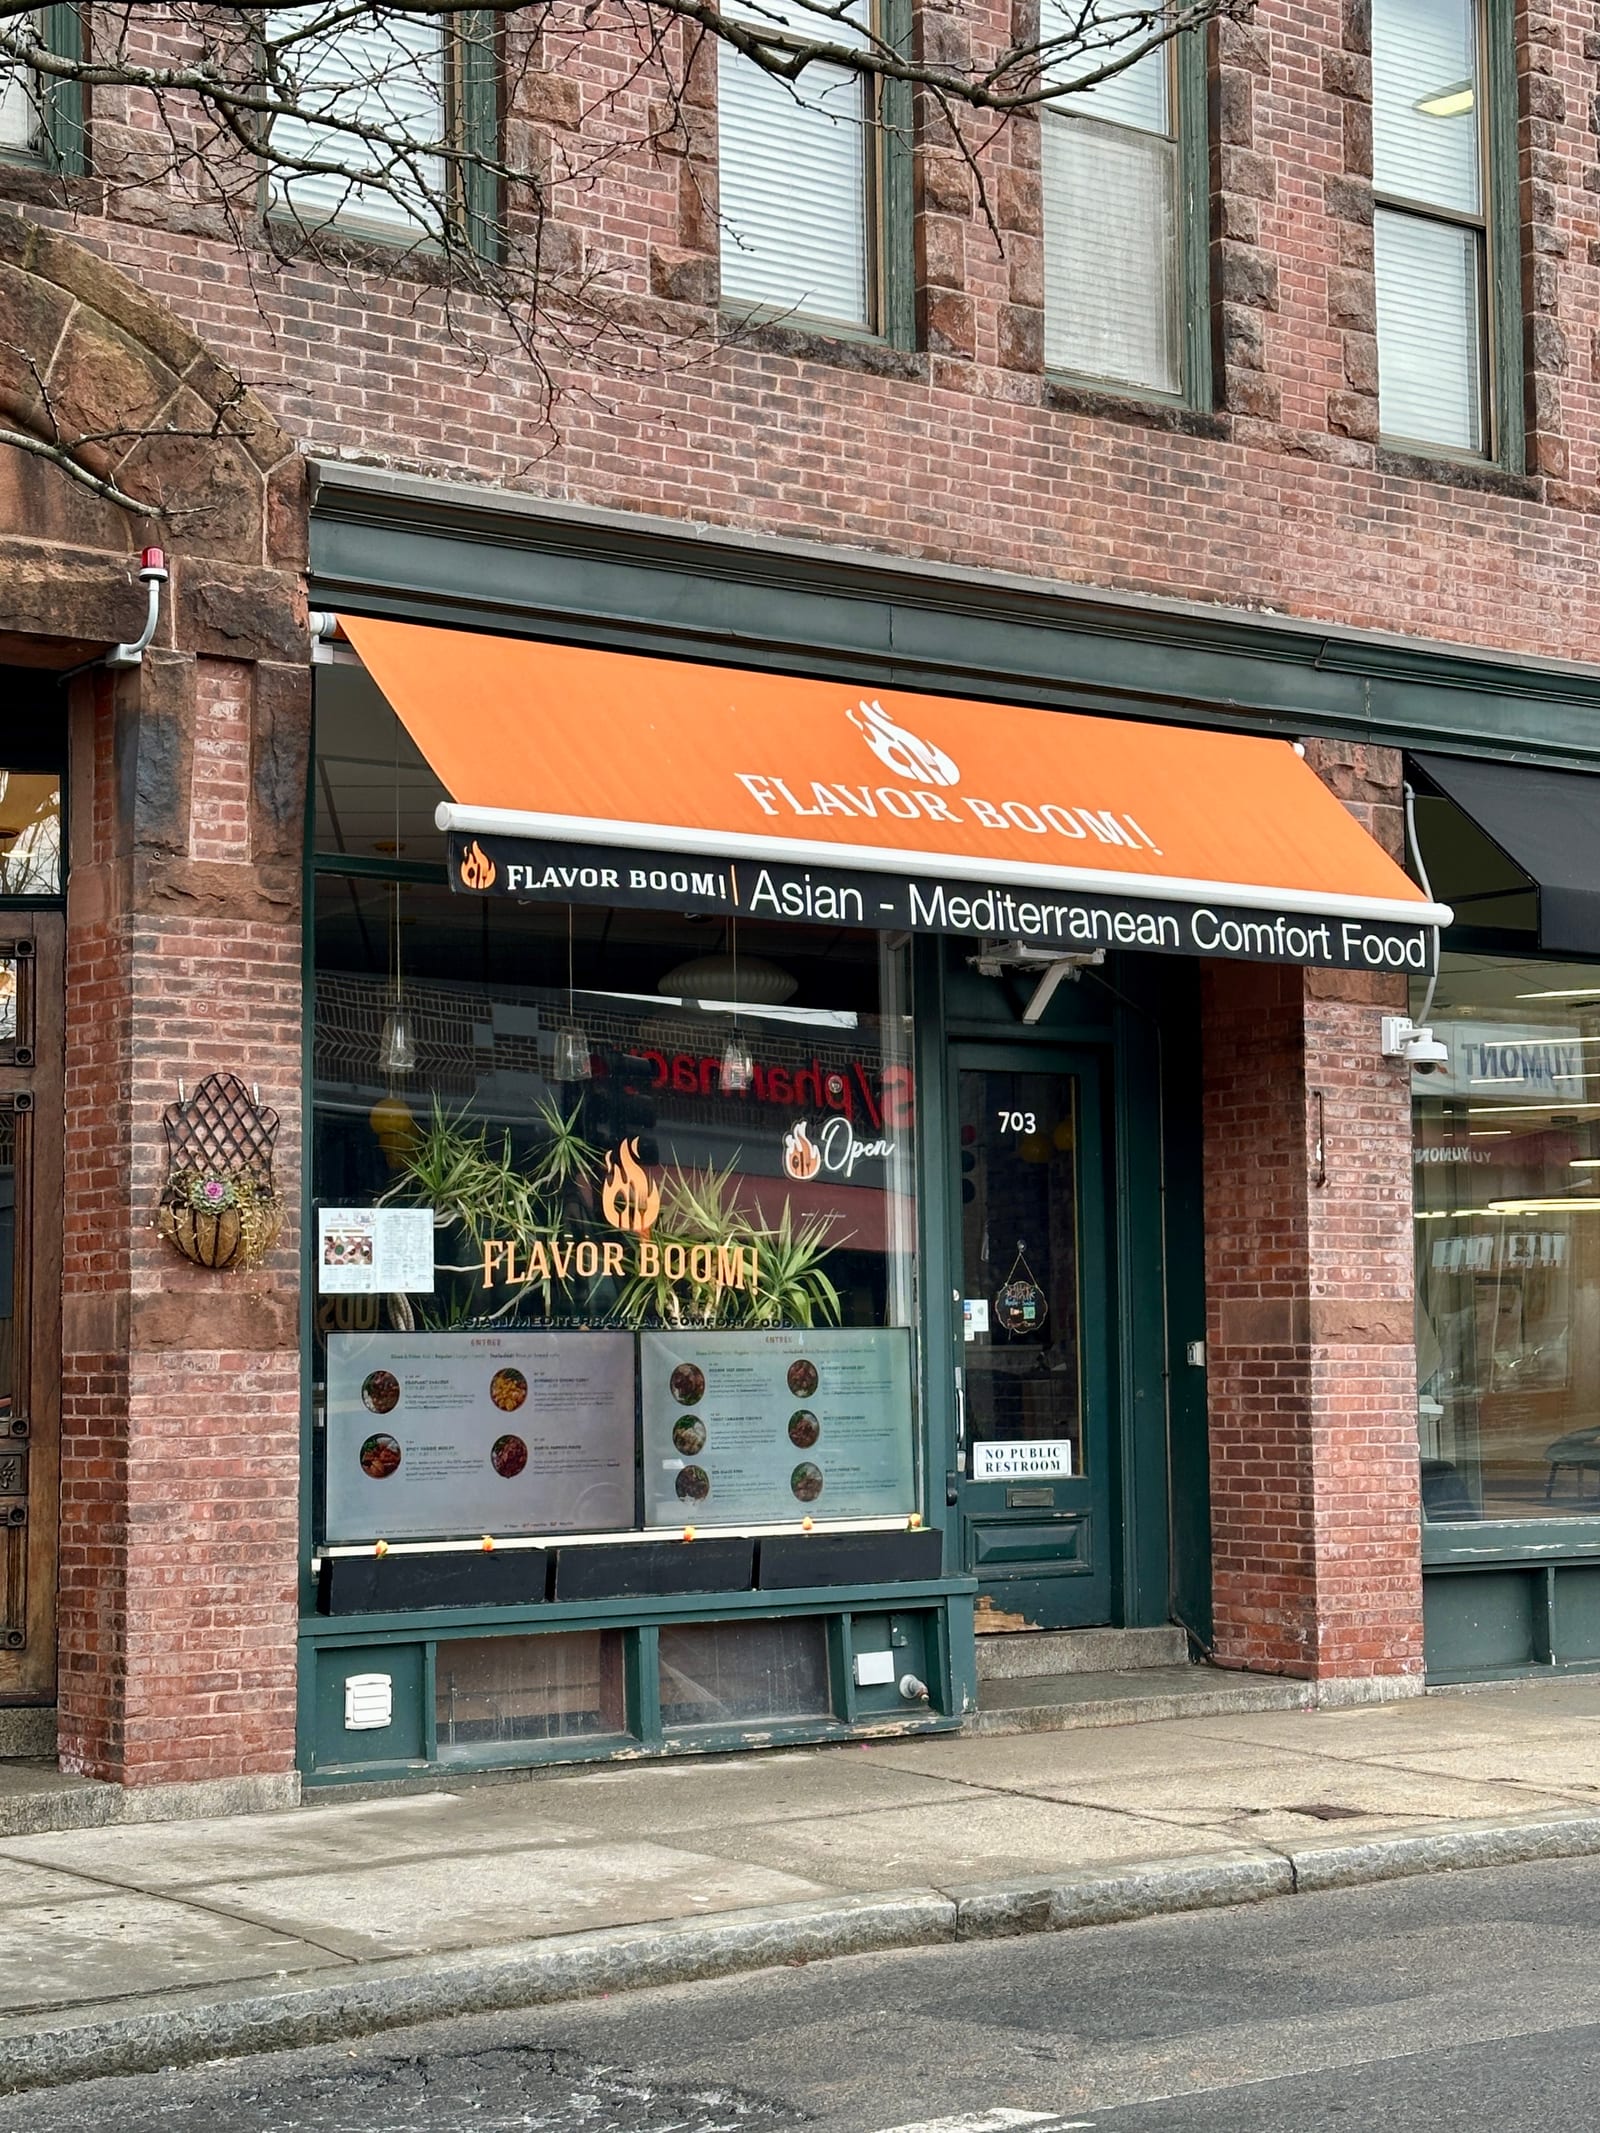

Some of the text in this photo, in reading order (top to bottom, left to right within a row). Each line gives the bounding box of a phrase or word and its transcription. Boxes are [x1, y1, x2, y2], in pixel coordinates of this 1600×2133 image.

[734, 772, 1164, 856] FLAVOR BOOM!
[506, 865, 619, 892] FLAVOR
[630, 870, 727, 899] BOOM!
[749, 870, 864, 921] Asian
[908, 883, 1180, 946] Mediterranean
[1191, 908, 1333, 961] Comfort
[1343, 923, 1426, 969] Food
[998, 1111, 1036, 1134] 703
[821, 1116, 896, 1178] Open
[482, 1239, 626, 1289] FLAVOR
[640, 1243, 760, 1295] BOOM!
[671, 1315, 747, 1328] COMFORT
[752, 1316, 794, 1329] FOOD
[985, 1446, 1061, 1460] NO PUBLIC
[985, 1460, 1061, 1473] RESTROOM
